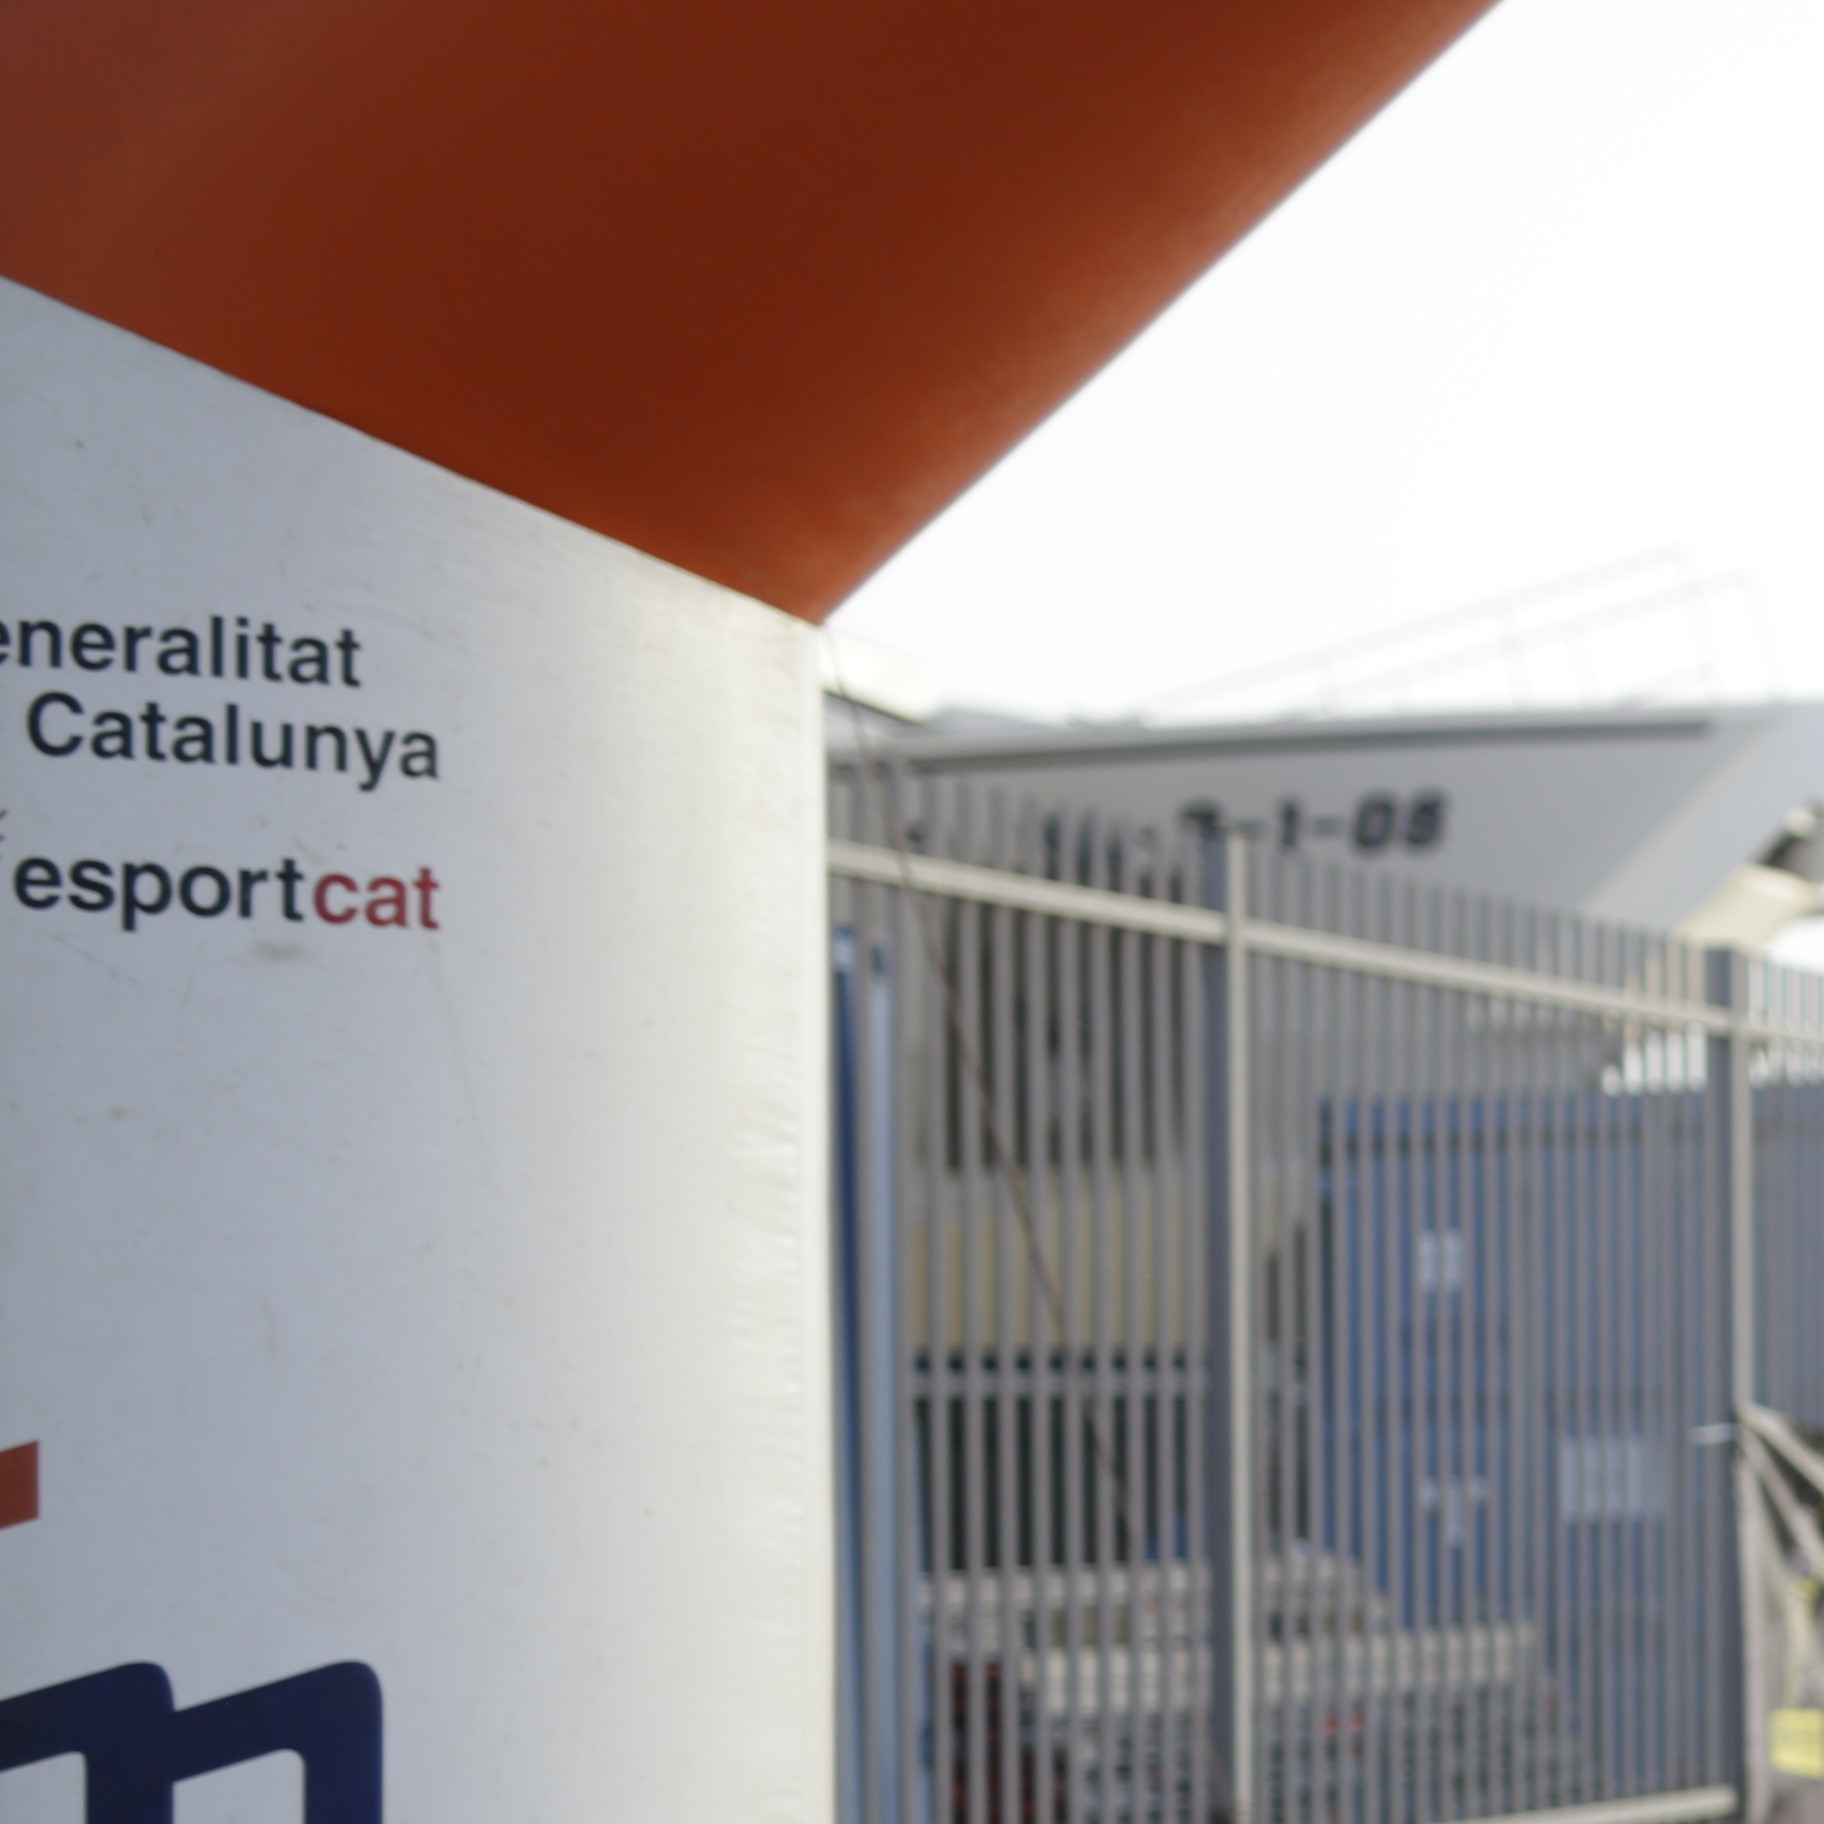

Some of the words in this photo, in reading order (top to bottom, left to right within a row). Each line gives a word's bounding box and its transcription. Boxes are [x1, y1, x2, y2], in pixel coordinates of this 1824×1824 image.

[0, 615, 362, 688] neralitat
[26, 691, 440, 792] Catalunya
[14, 854, 441, 933] esportcat
